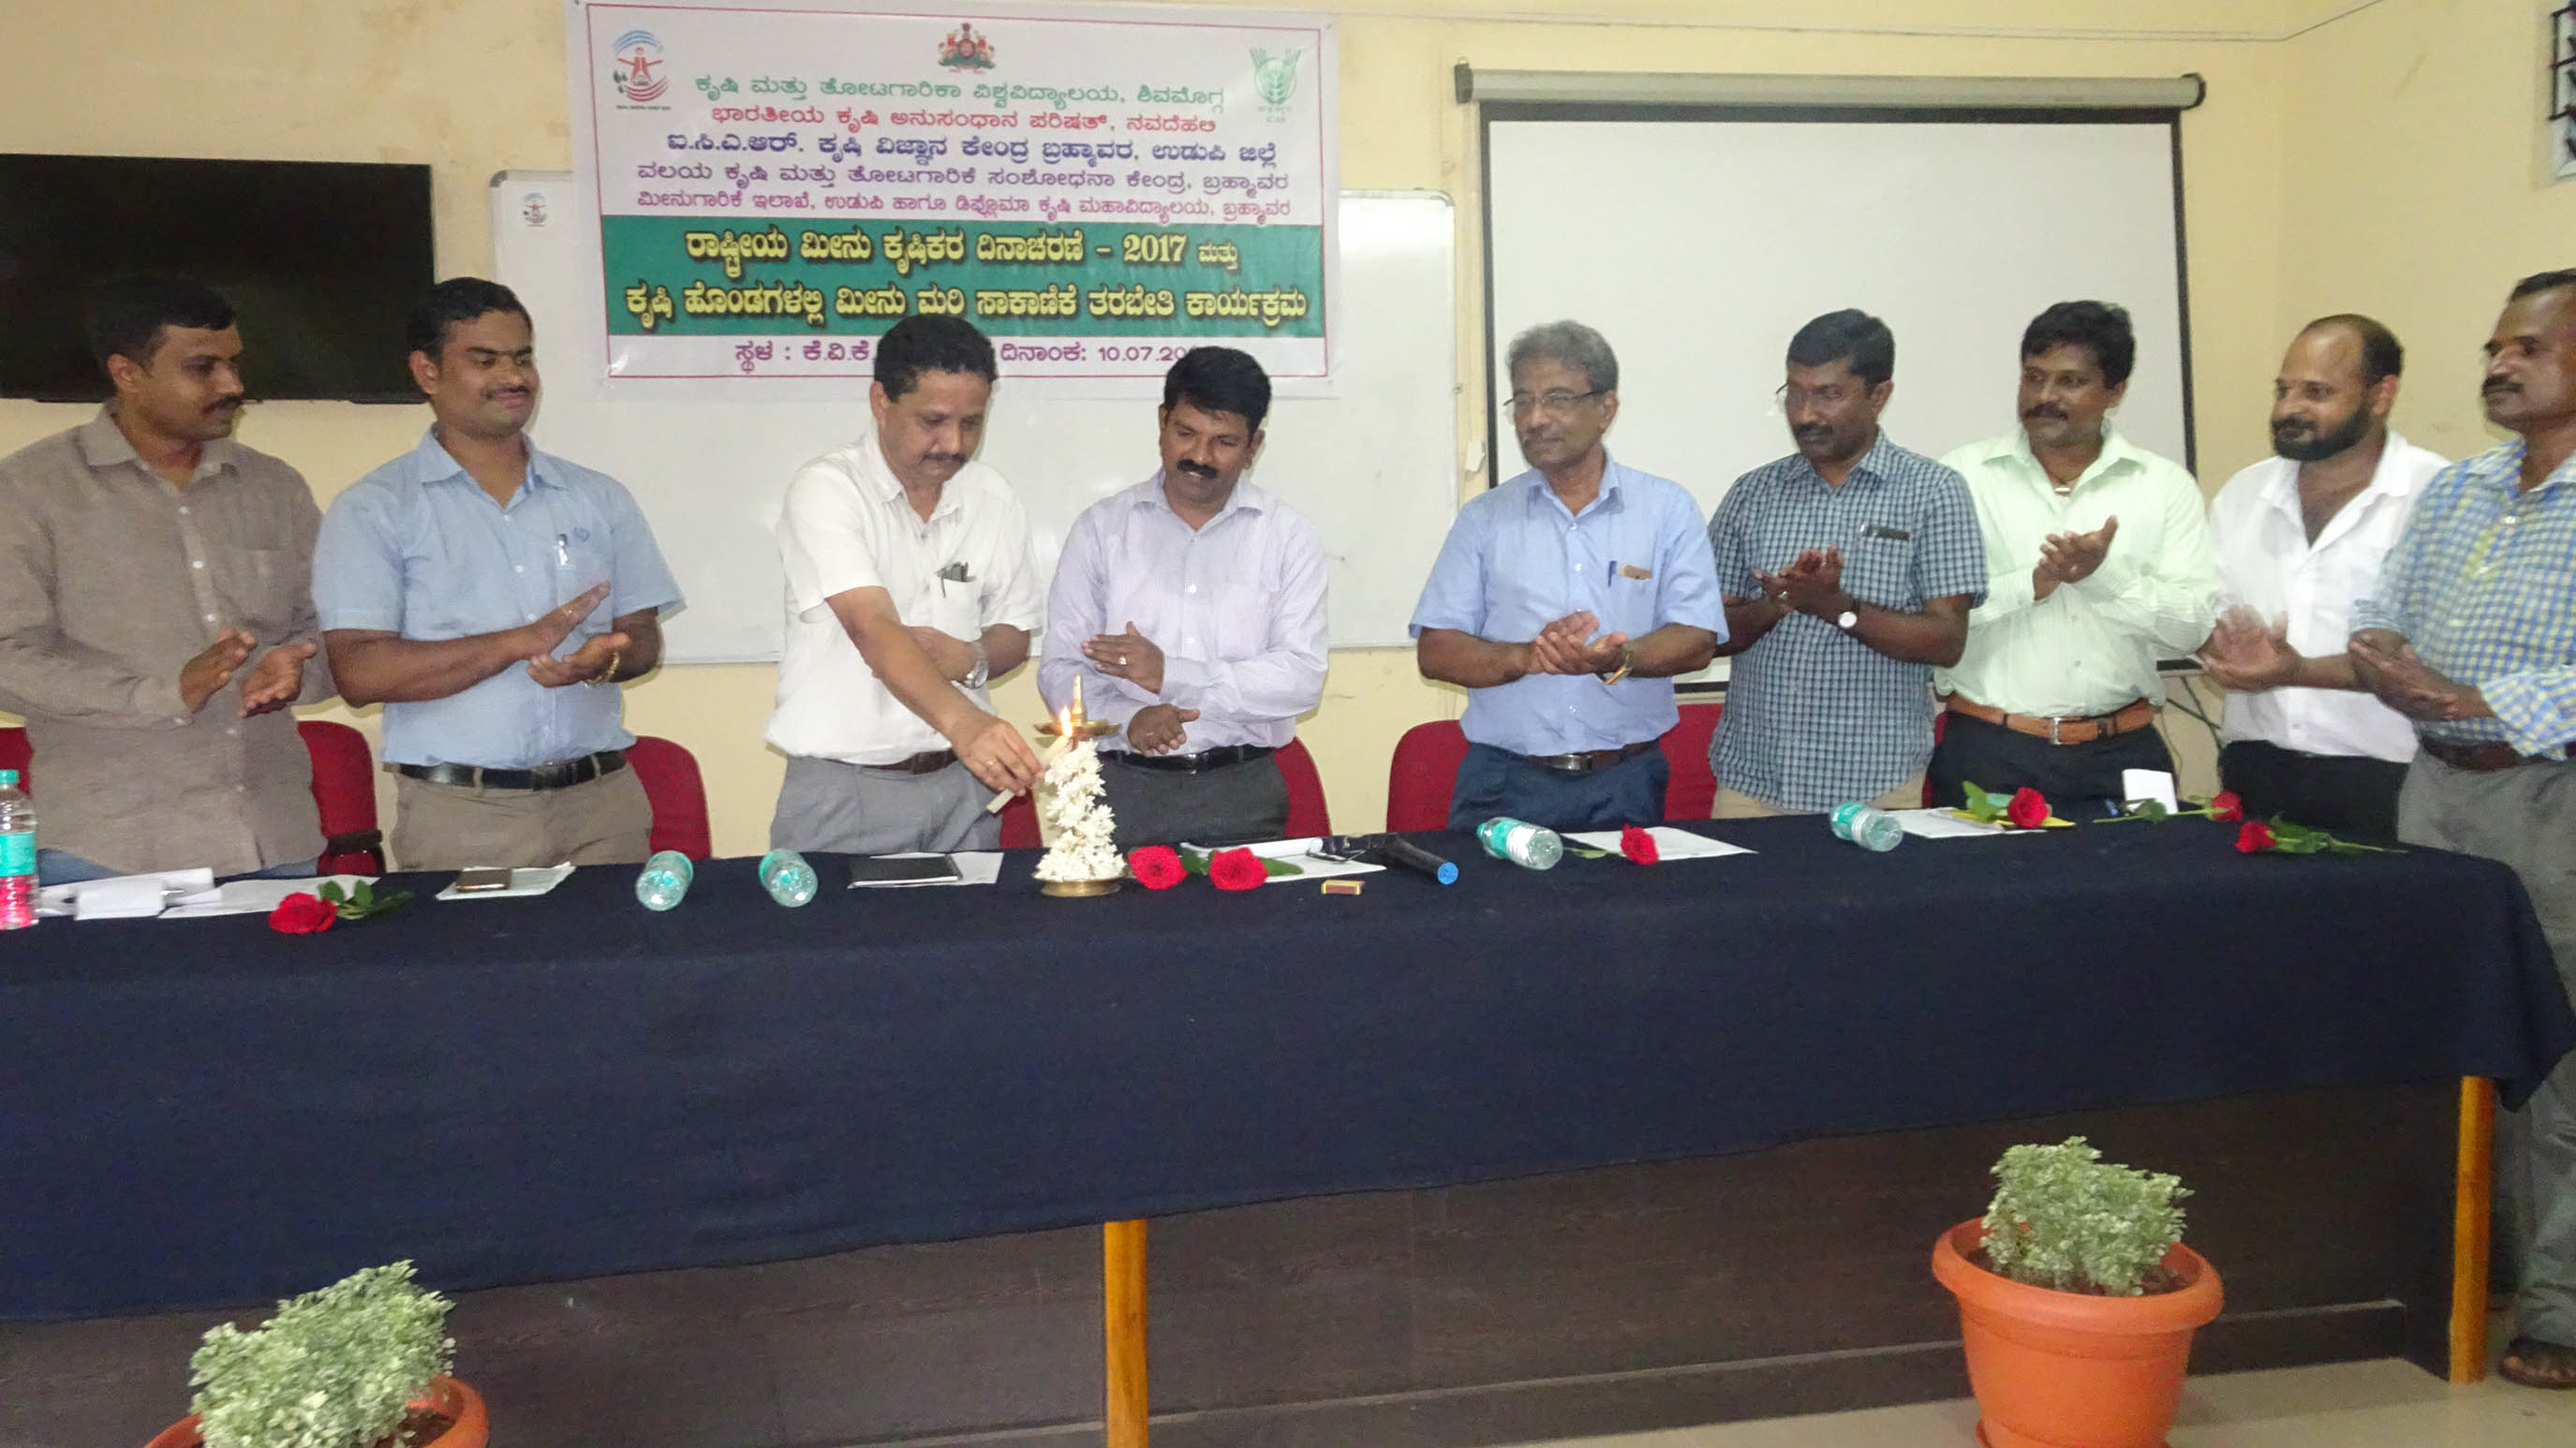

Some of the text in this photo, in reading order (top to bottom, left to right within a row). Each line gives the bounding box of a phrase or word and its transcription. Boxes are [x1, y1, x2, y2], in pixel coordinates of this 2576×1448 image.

[695, 74, 739, 101] ಕೃಷಿ
[750, 76, 807, 100] ಮತ್ತು
[1136, 83, 1223, 112] ಶಿವಮೊಗ್ಗ
[711, 104, 825, 125] ಭಾರತೀಯ
[836, 107, 880, 134] ಕೃಷಿ
[891, 109, 1018, 129] ಅನುಸಂಧಾನ
[819, 134, 863, 162] ಕೃಷಿ
[876, 135, 948, 166] ವಿಜ್ಞಾನ
[962, 136, 1029, 163] ಕೇಂದ್ರ
[1152, 142, 1226, 162] ಉಡುಪಿ
[1238, 141, 1277, 169] ಜಿಲ್ಲೆ
[637, 162, 713, 179] ವಲಯ
[724, 163, 769, 188] ಕೃಷಿ
[779, 164, 836, 187] ಮತ್ತು
[848, 165, 976, 185] ತೋಟಗಾರಿಕೆ
[988, 168, 1116, 188] ಸಂಶೋಧನಾ
[1203, 172, 1289, 198] ಬ್ರಹ್ಮಾವರ
[637, 189, 744, 209] ಮೀನುಗಾರಿಕೆ
[824, 193, 884, 210] ಉಡುಪಿ
[893, 194, 947, 211] ಹಾಗೂ
[1038, 196, 1072, 221] ಕೃಷಿ
[686, 226, 789, 278] ರಾಷ್ಟ್ರೀಯ
[800, 227, 872, 260] ಮೀನು
[882, 227, 966, 274] ಕೃಷಿಕರ
[976, 229, 1084, 262] ದಿನಾಚರಣೆ
[1123, 233, 1188, 263] 2017
[1197, 240, 1239, 272] ಮತ್ತು
[625, 279, 1307, 329] ಕೃಷಿ ಹೊಂಡಗಳಲ್ಲಿ ಮೀನು ಮರಿ ಸಾಕಾಣಿಕೆ ತರಬೇತಿ ಕಾರ್ಯಕ್ರಮ
[735, 340, 773, 374] ಸ್ಥಳ
[1098, 347, 1189, 362] 10.07.20
